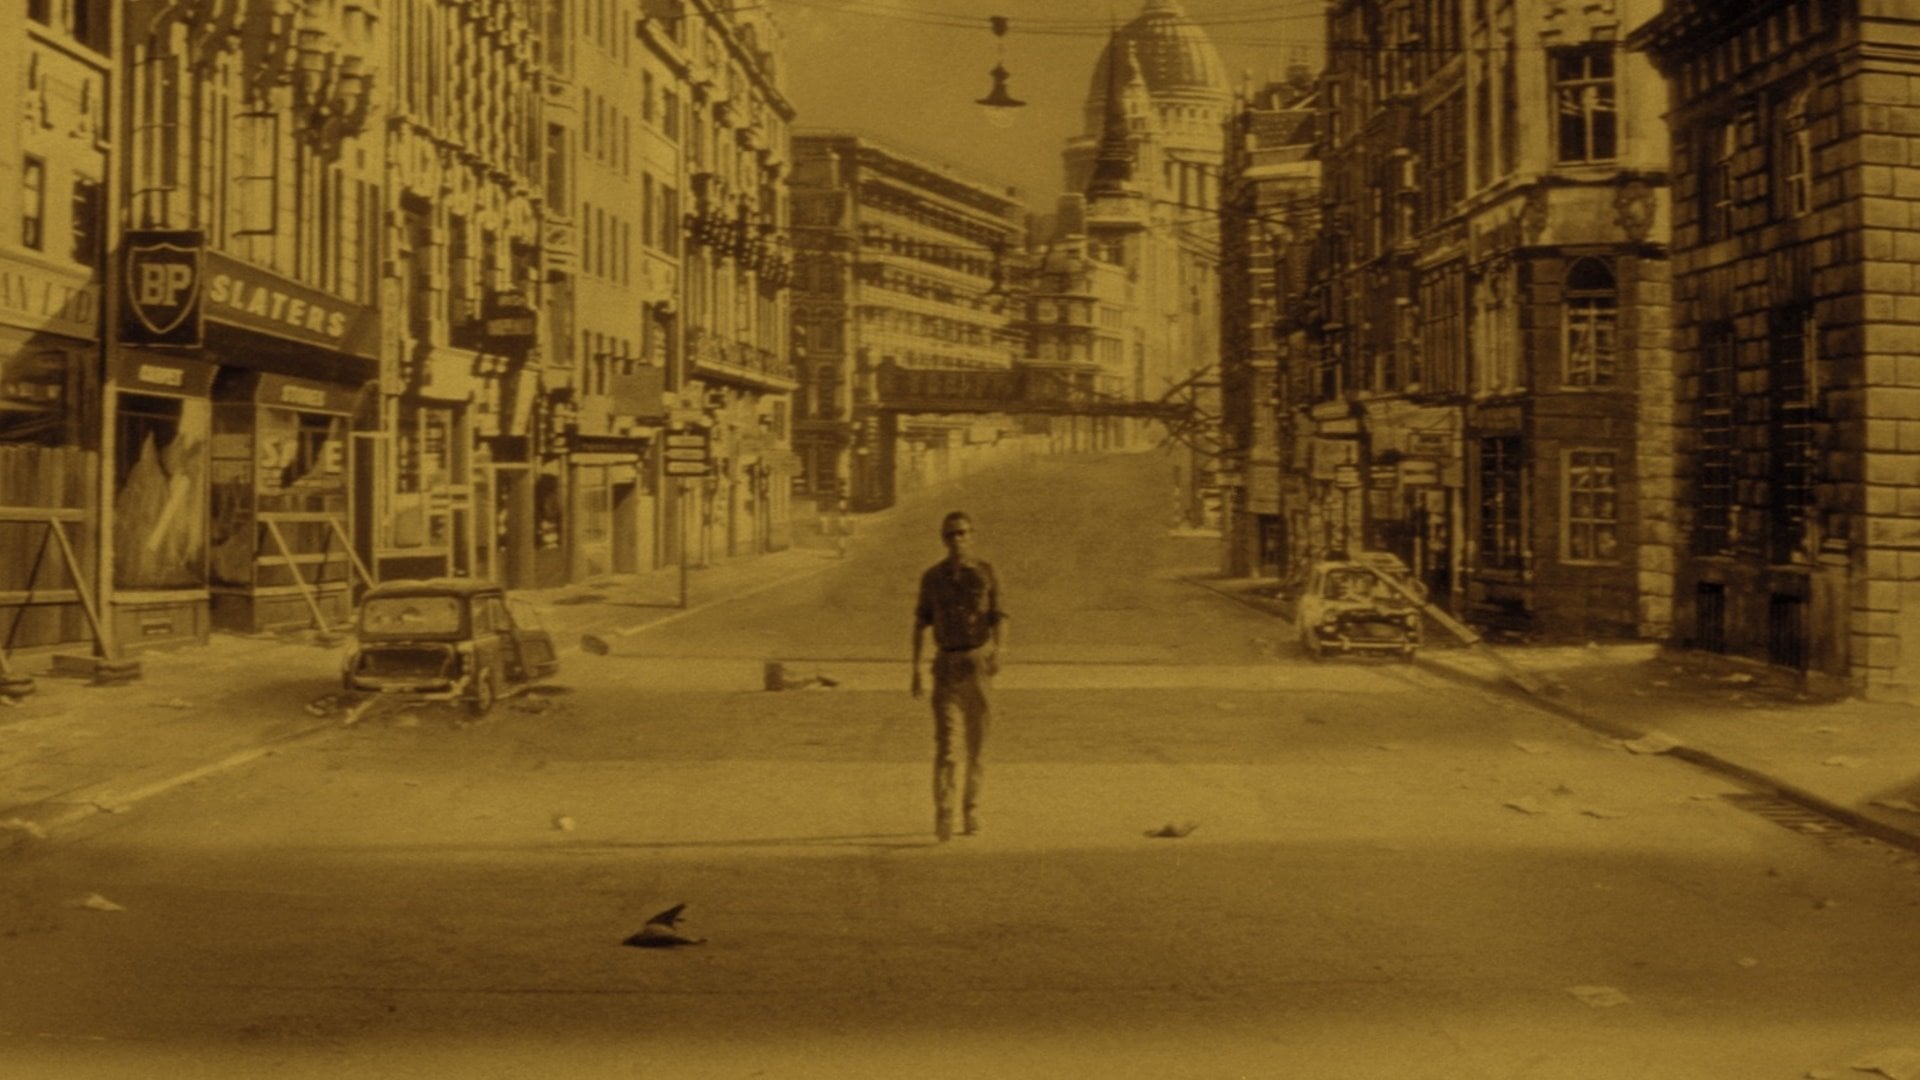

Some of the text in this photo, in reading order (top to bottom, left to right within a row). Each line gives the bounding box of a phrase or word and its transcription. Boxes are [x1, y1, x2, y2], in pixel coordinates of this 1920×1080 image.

[141, 263, 192, 306] BP
[210, 274, 346, 338] SLATERS
[260, 437, 343, 473] SE
